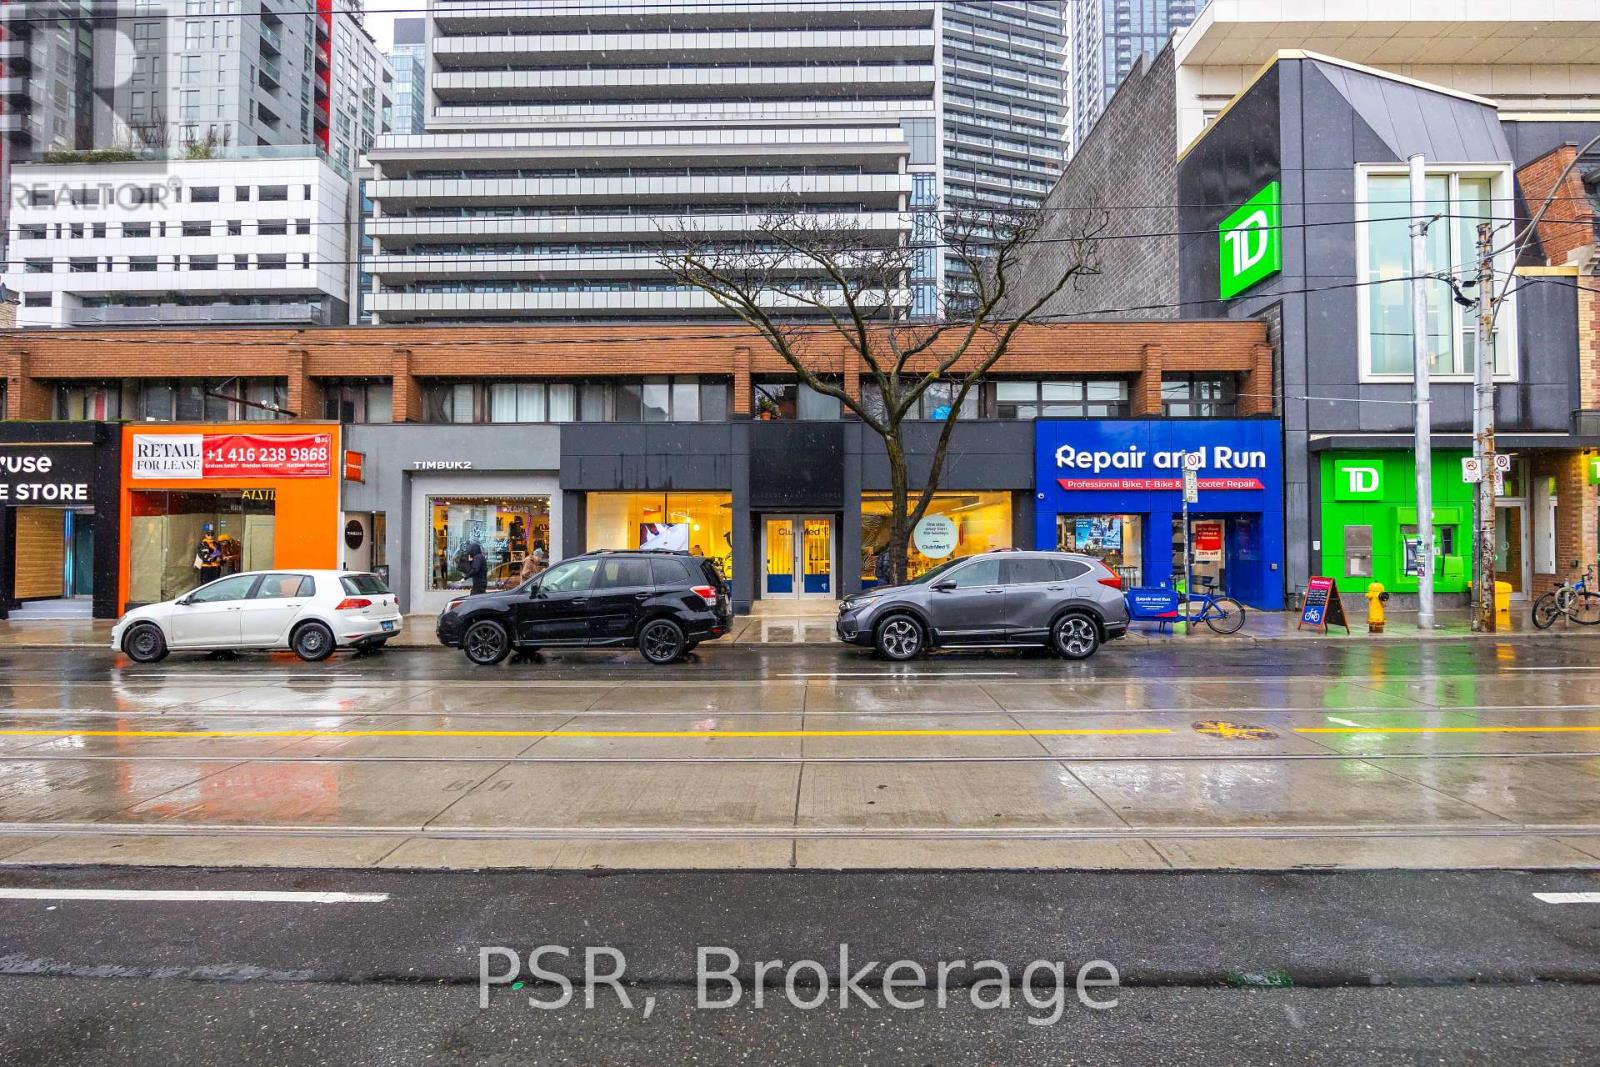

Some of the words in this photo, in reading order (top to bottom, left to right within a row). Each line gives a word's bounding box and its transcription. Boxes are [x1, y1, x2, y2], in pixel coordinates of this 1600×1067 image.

[1225, 210, 1268, 277] TD
[137, 443, 200, 458] RETAIL
[206, 448, 224, 462] +1
[227, 448, 256, 462] 416
[259, 448, 287, 462] 238
[290, 447, 328, 461] 9868
[137, 460, 160, 470] FOR
[163, 459, 200, 470] LEASE
[413, 461, 472, 469] TIMBUK2
[1056, 444, 1146, 473] Repair
[1214, 446, 1266, 469] Run
[1122, 481, 1143, 489] Bike,
[1227, 481, 1256, 490] Repair
[1342, 467, 1380, 492] TD
[15, 484, 88, 500] STORE
[778, 527, 793, 536] Clu
